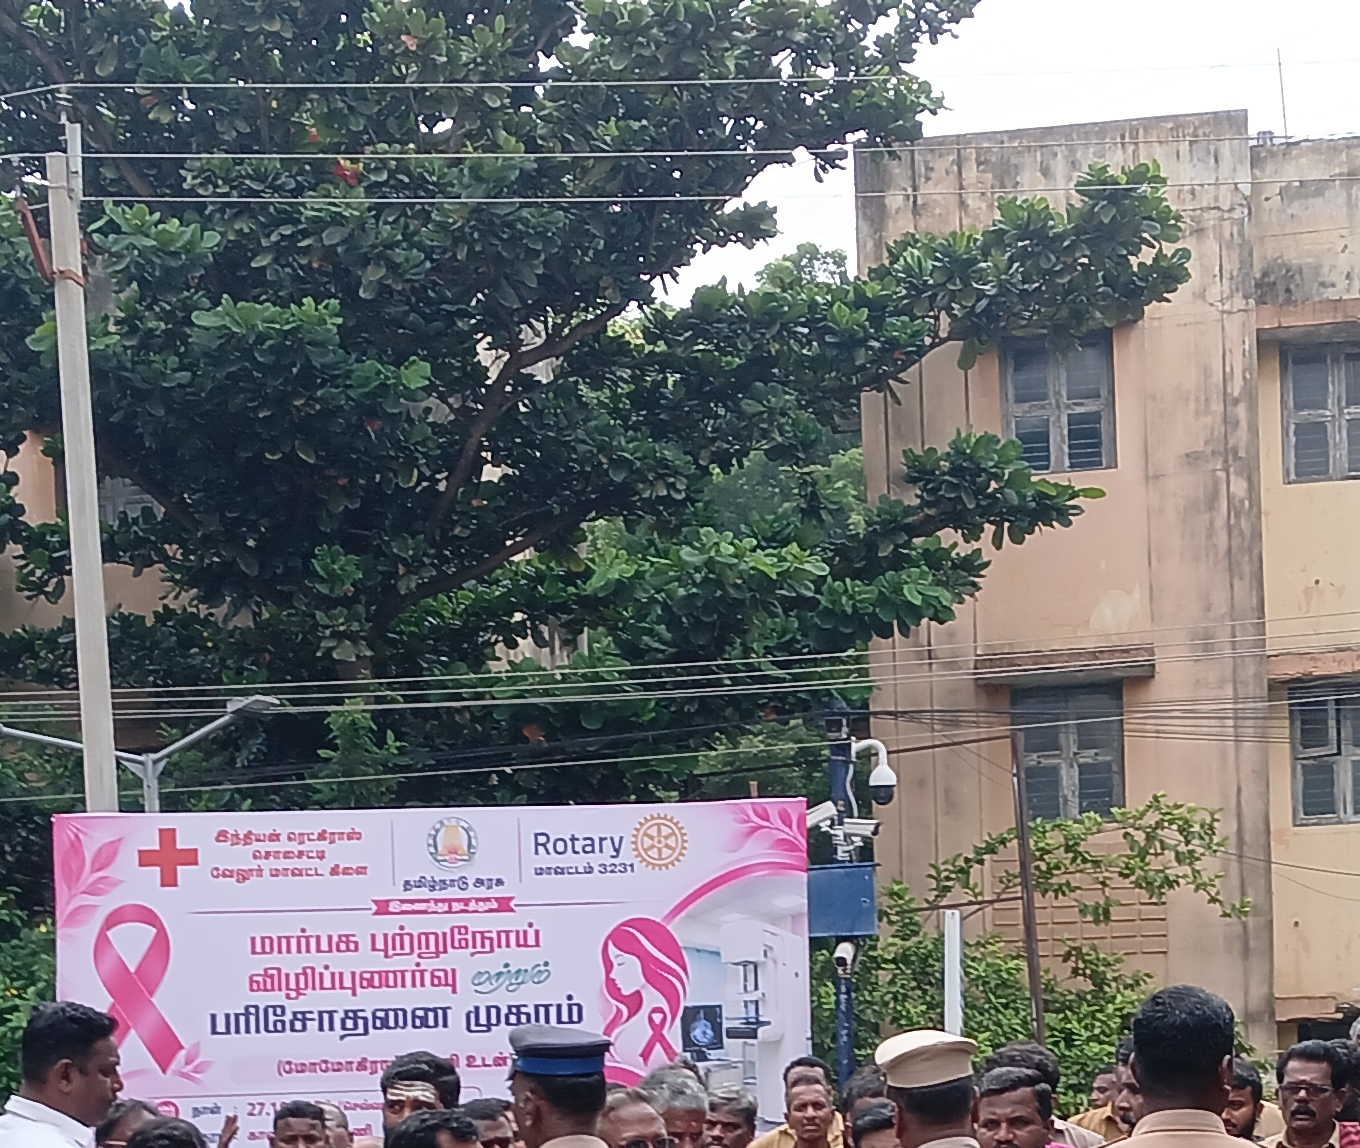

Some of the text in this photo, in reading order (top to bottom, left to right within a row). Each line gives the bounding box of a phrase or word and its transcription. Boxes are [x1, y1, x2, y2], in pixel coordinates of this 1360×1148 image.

[214, 828, 281, 847] இந்தியன்
[533, 832, 624, 859] Rotary
[210, 863, 369, 884] வேலூர் மாவட்ட கிளை
[533, 862, 635, 876] மாவட்டம் 3231
[402, 875, 505, 893] தமிழ்நாடு அரசு
[249, 921, 541, 960] மார்பக புற்றுநோய்
[248, 960, 552, 1001] விழிப்புணர்வு மற்றும்
[209, 993, 584, 1041] பரிசோதனை முகாம்
[191, 1102, 222, 1119] நாள்
